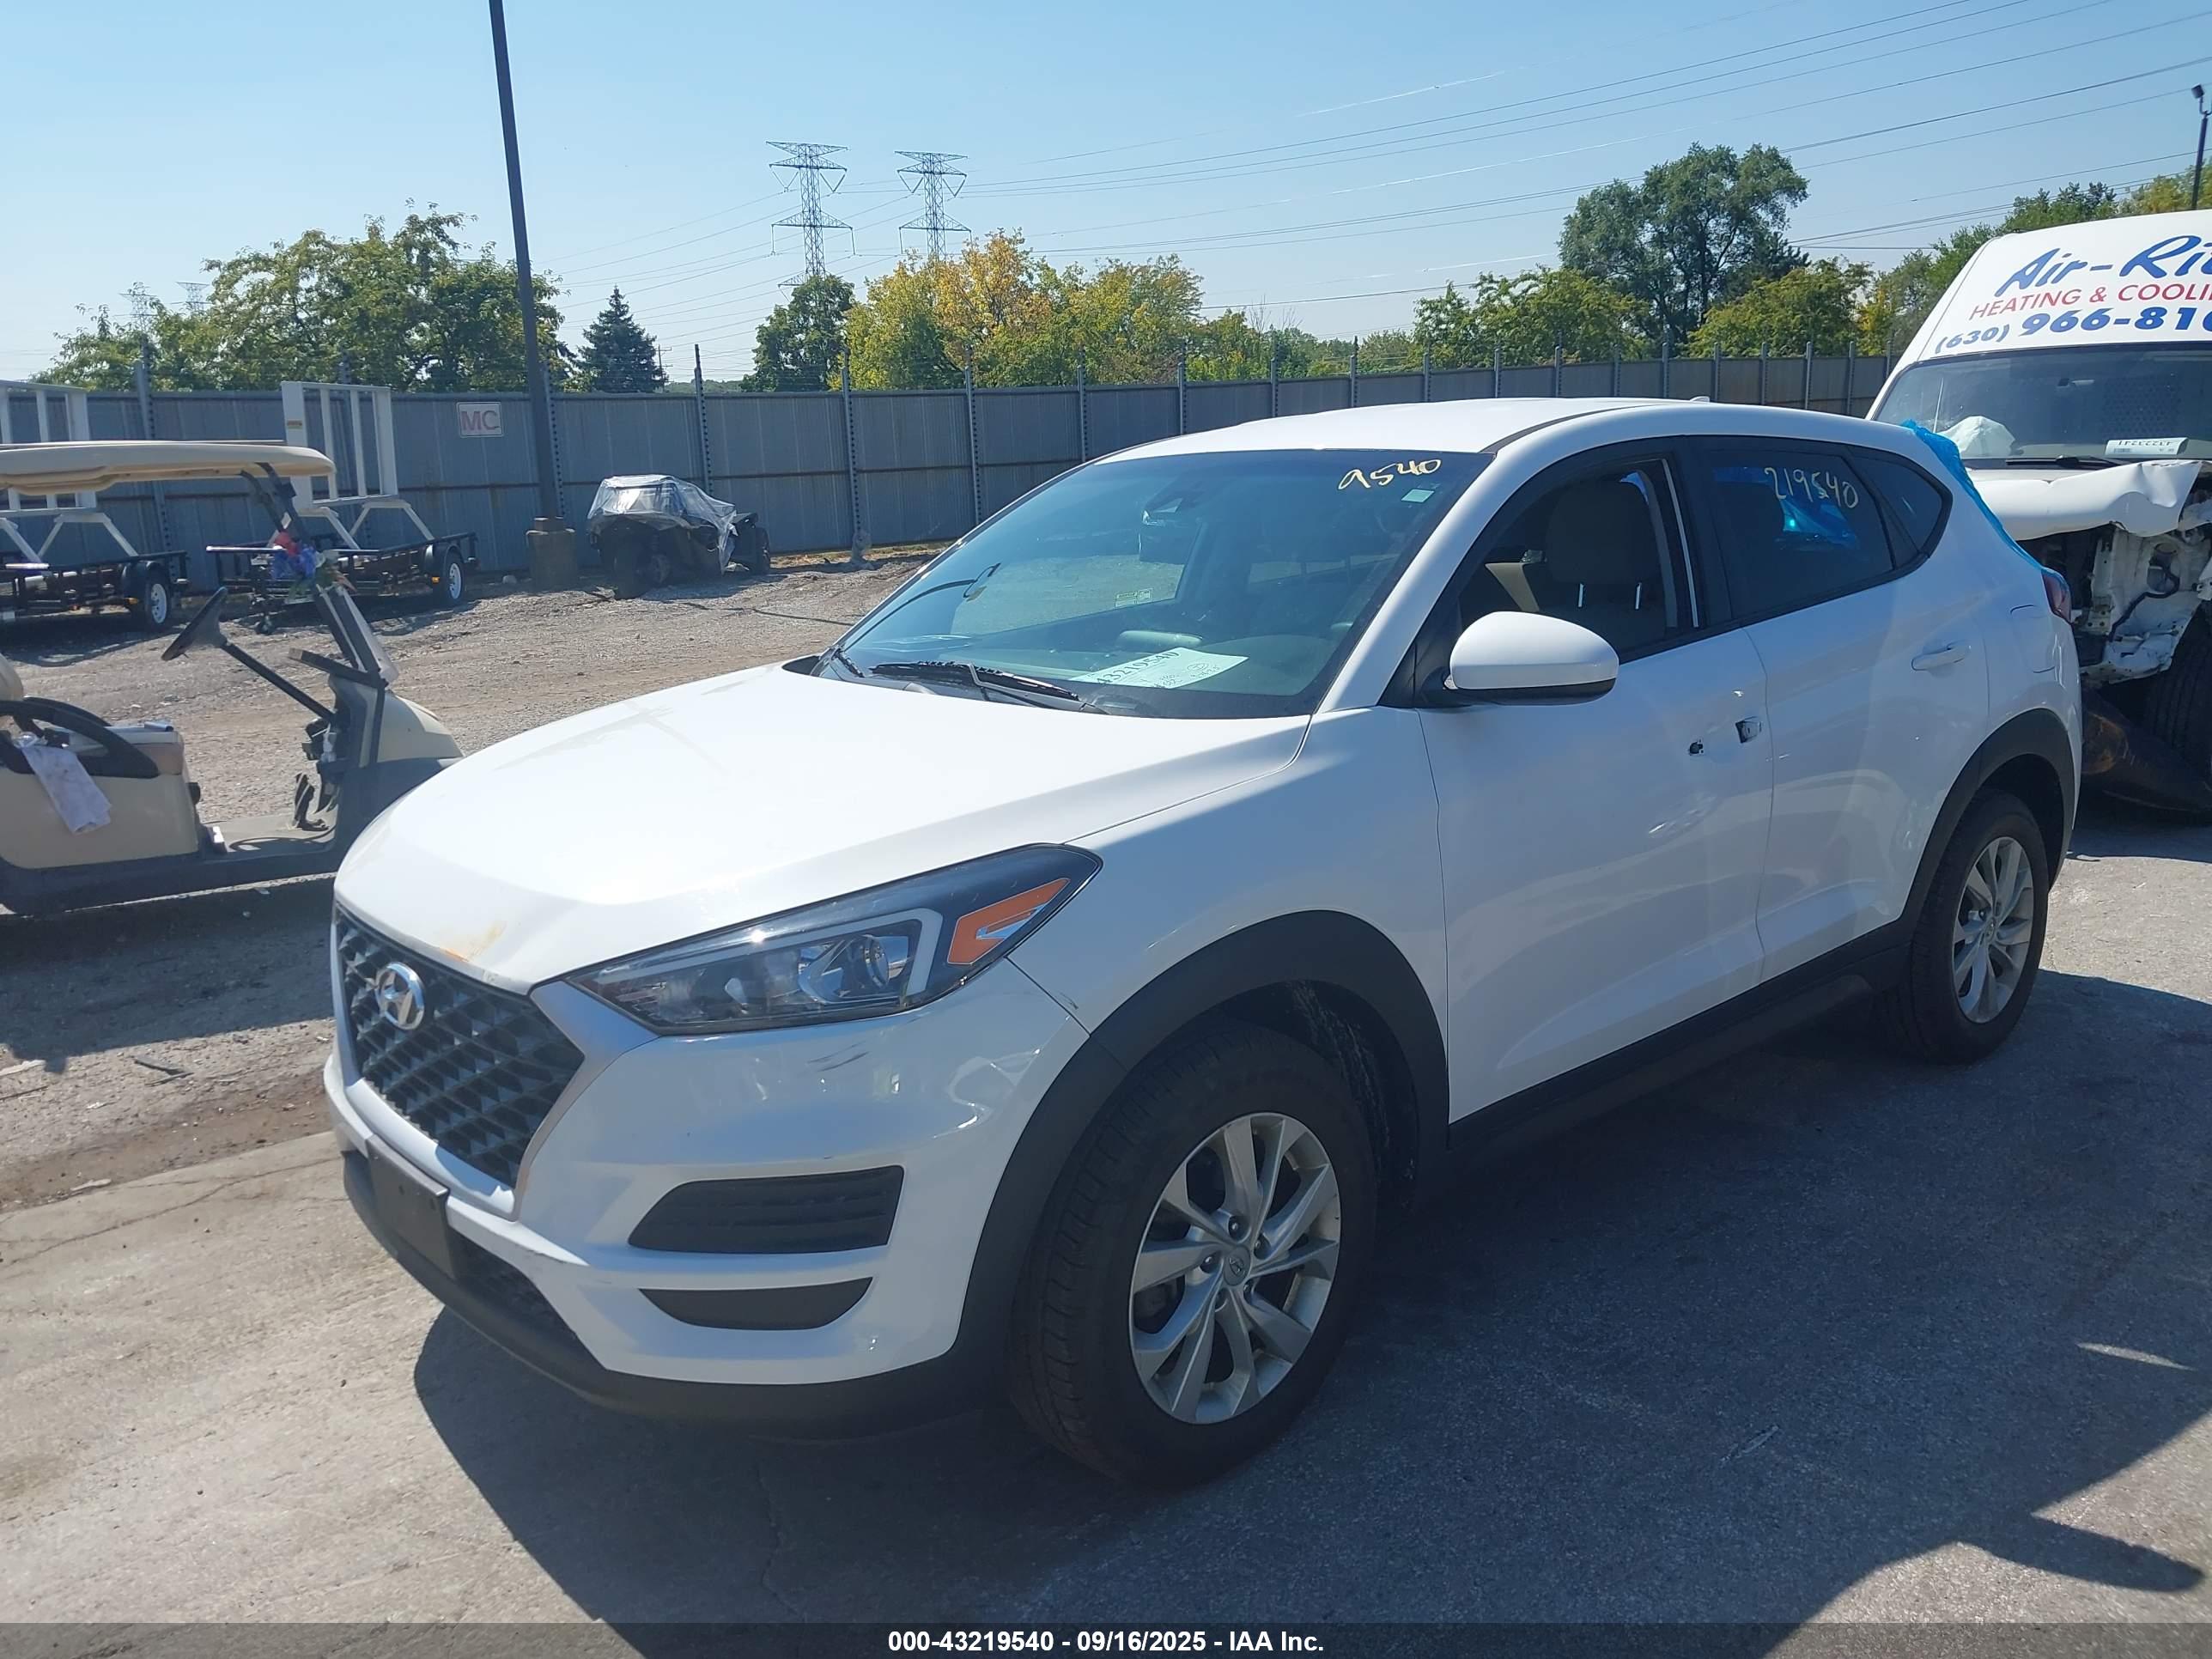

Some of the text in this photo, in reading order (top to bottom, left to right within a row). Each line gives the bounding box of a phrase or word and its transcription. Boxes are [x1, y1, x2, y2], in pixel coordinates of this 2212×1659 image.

[1969, 283, 2212, 320] HEATING & COOLI
[1935, 324, 2010, 354] (630)
[461, 410, 500, 430] MC
[1764, 467, 1859, 508] 219540
[1097, 651, 1180, 684] 43219540
